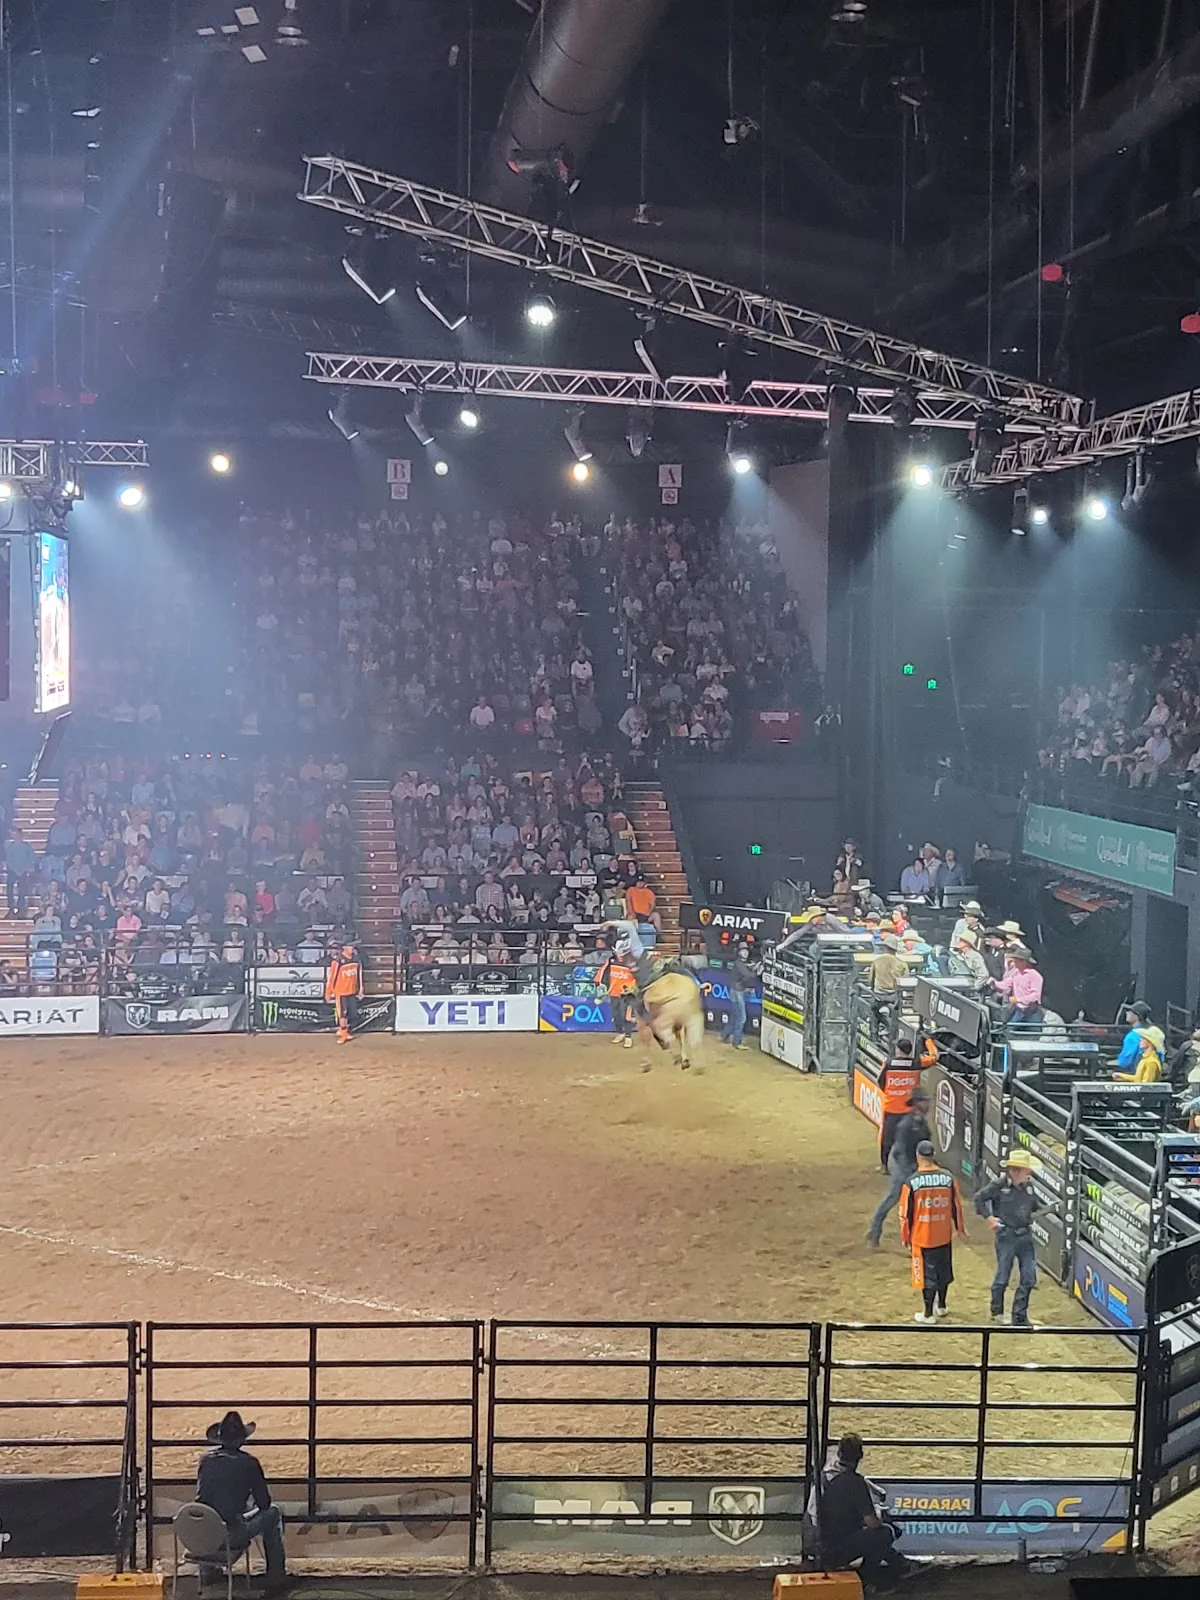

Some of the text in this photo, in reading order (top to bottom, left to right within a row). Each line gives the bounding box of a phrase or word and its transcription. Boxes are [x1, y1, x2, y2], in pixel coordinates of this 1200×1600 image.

[393, 462, 406, 479] B
[663, 467, 676, 484] A
[712, 913, 762, 930] ARIAT
[157, 1006, 229, 1022] RAM
[419, 1000, 506, 1025] YETI
[562, 1004, 604, 1023] POA
[937, 999, 961, 1023] RAM
[859, 1082, 882, 1123] neds
[1065, 1141, 1078, 1250] Priefert
[1086, 1264, 1106, 1307] POA
